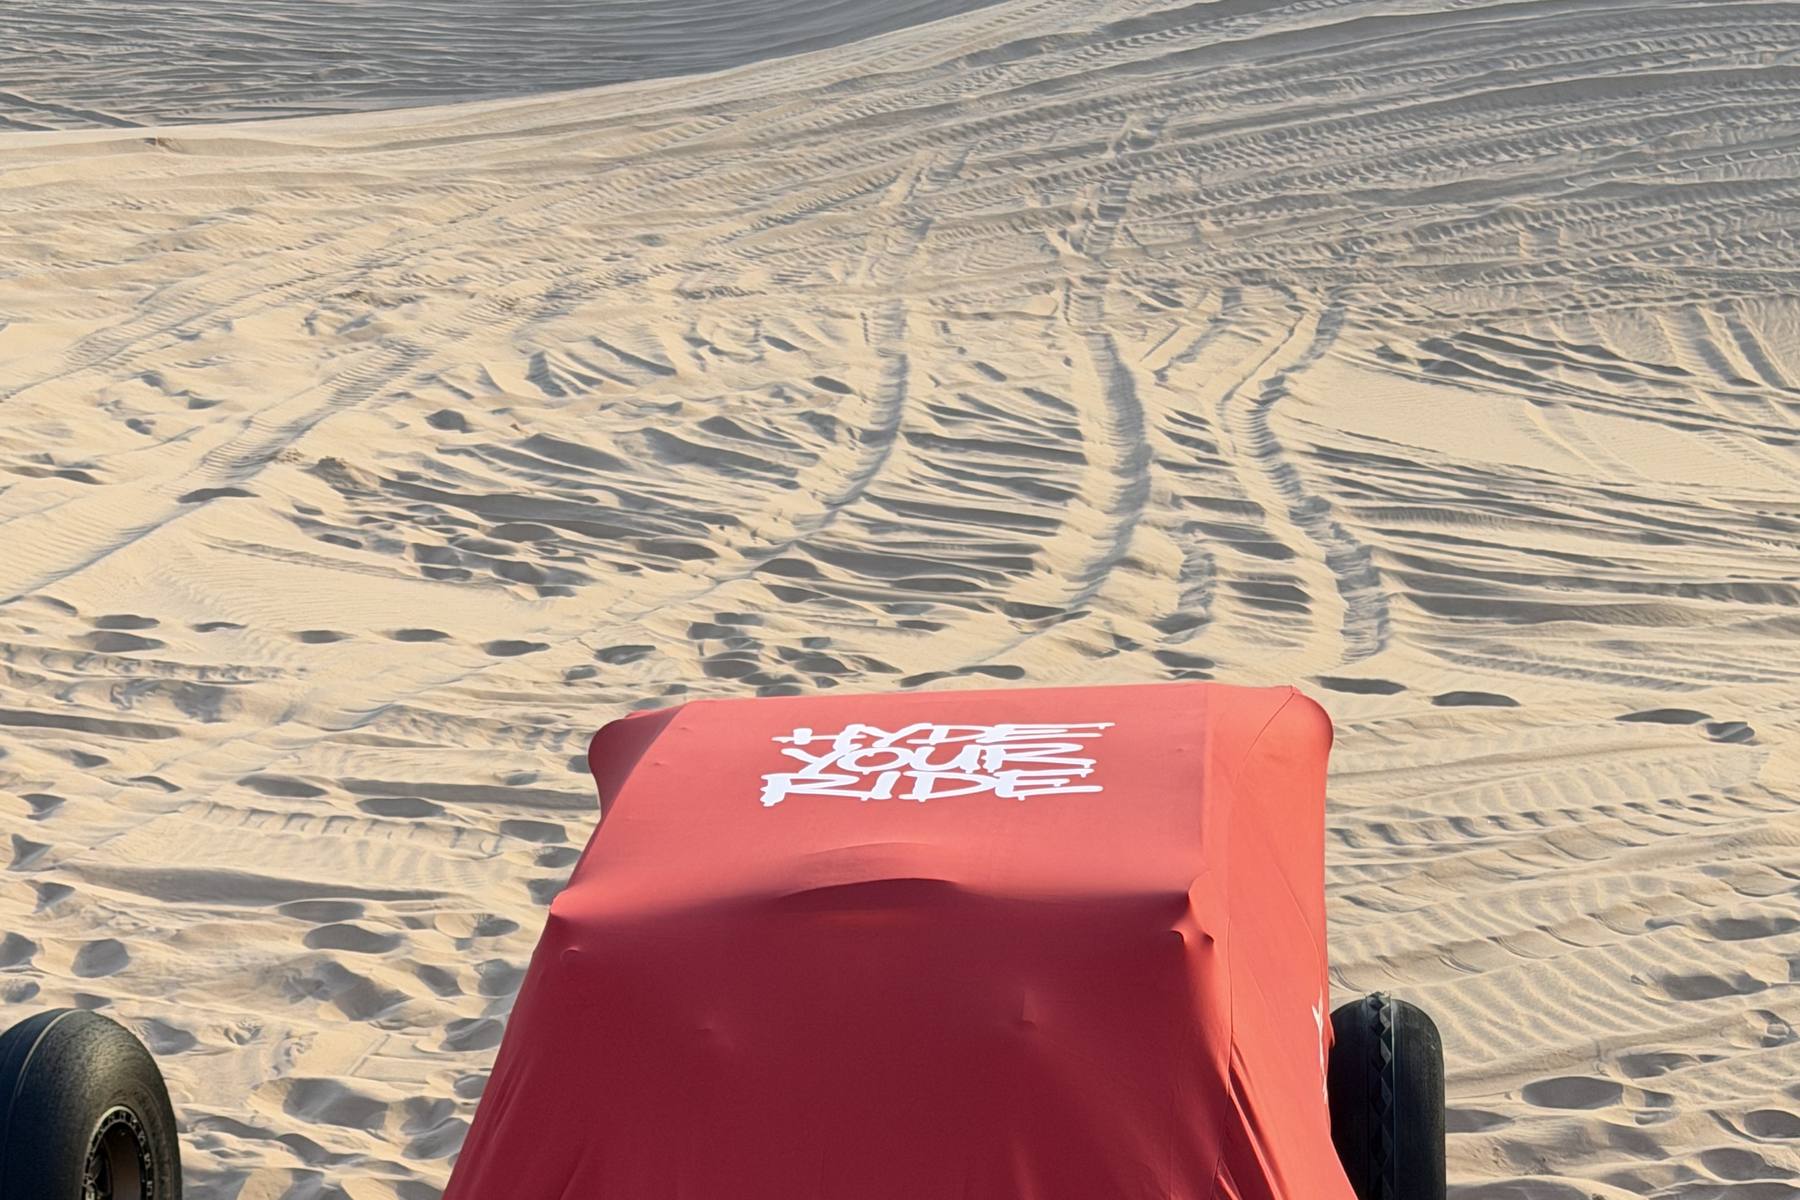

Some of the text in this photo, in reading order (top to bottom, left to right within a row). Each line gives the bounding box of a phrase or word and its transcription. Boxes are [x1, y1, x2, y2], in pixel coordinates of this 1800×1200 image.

[771, 722, 1115, 751] HYDE
[781, 743, 1096, 775] YOUR
[760, 769, 1104, 807] RIDE
